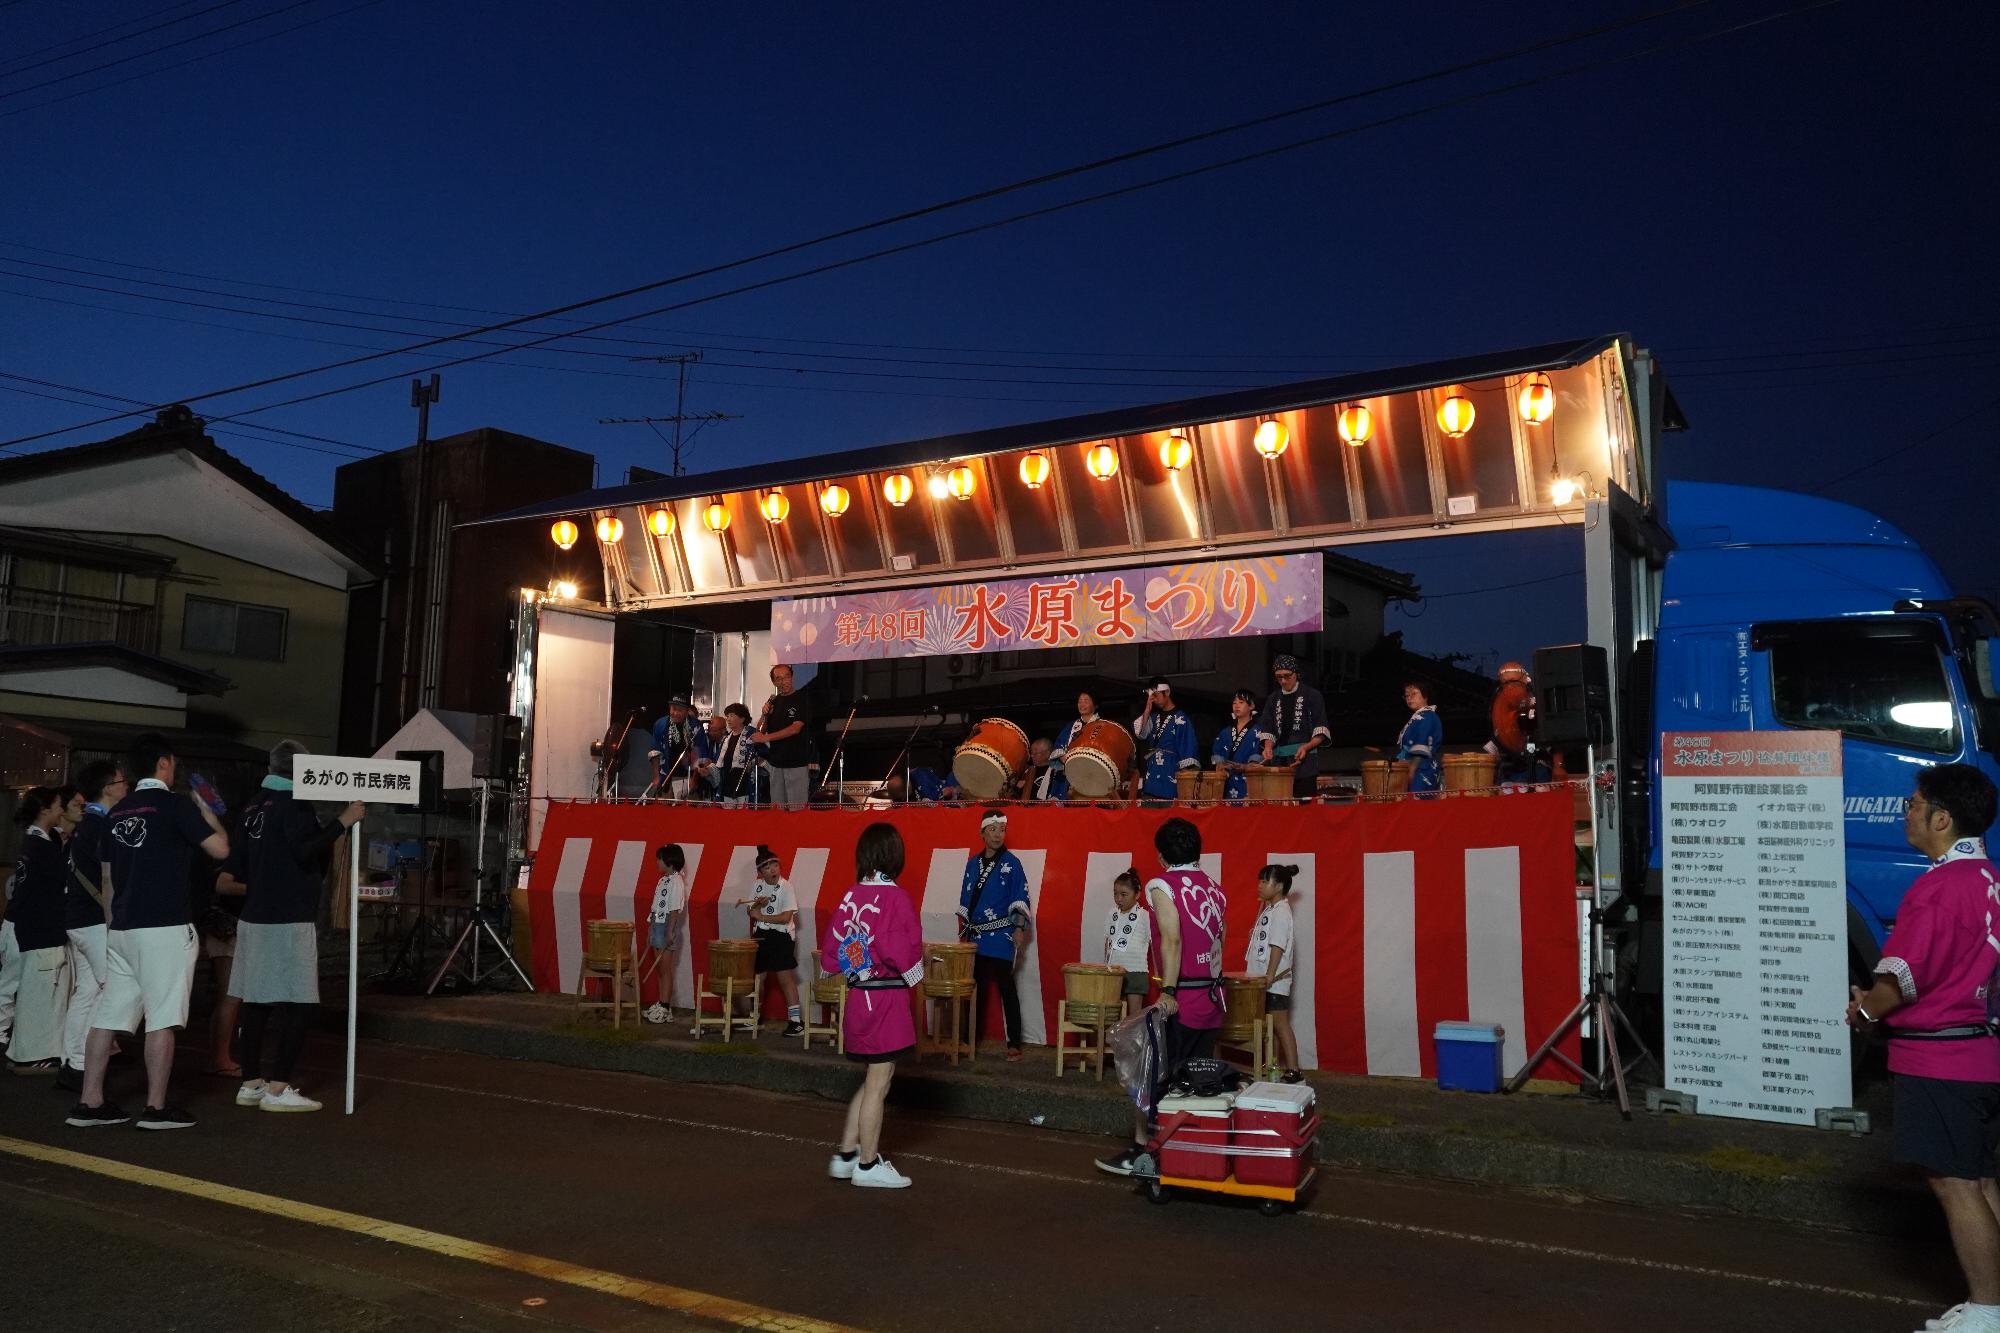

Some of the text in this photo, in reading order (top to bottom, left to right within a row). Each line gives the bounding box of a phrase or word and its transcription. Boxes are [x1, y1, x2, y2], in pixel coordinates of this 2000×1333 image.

[834, 568, 1258, 651] 第48回 水原まつり
[1674, 750, 1754, 767] 水原まつり
[302, 769, 411, 790] あがの市民病院
[1694, 783, 1808, 796] 阿賀野市建設業協会
[1670, 802, 1738, 812] 阿賀野市商工会
[1671, 818, 1727, 828] (株)ウオロク
[1867, 815, 1896, 824] Group
[1757, 820, 1834, 831] (株)水原自動車学校
[1671, 835, 1746, 846] 亀田製菓(株)水原工場
[1671, 851, 1725, 859] 阿賀野アスコン
